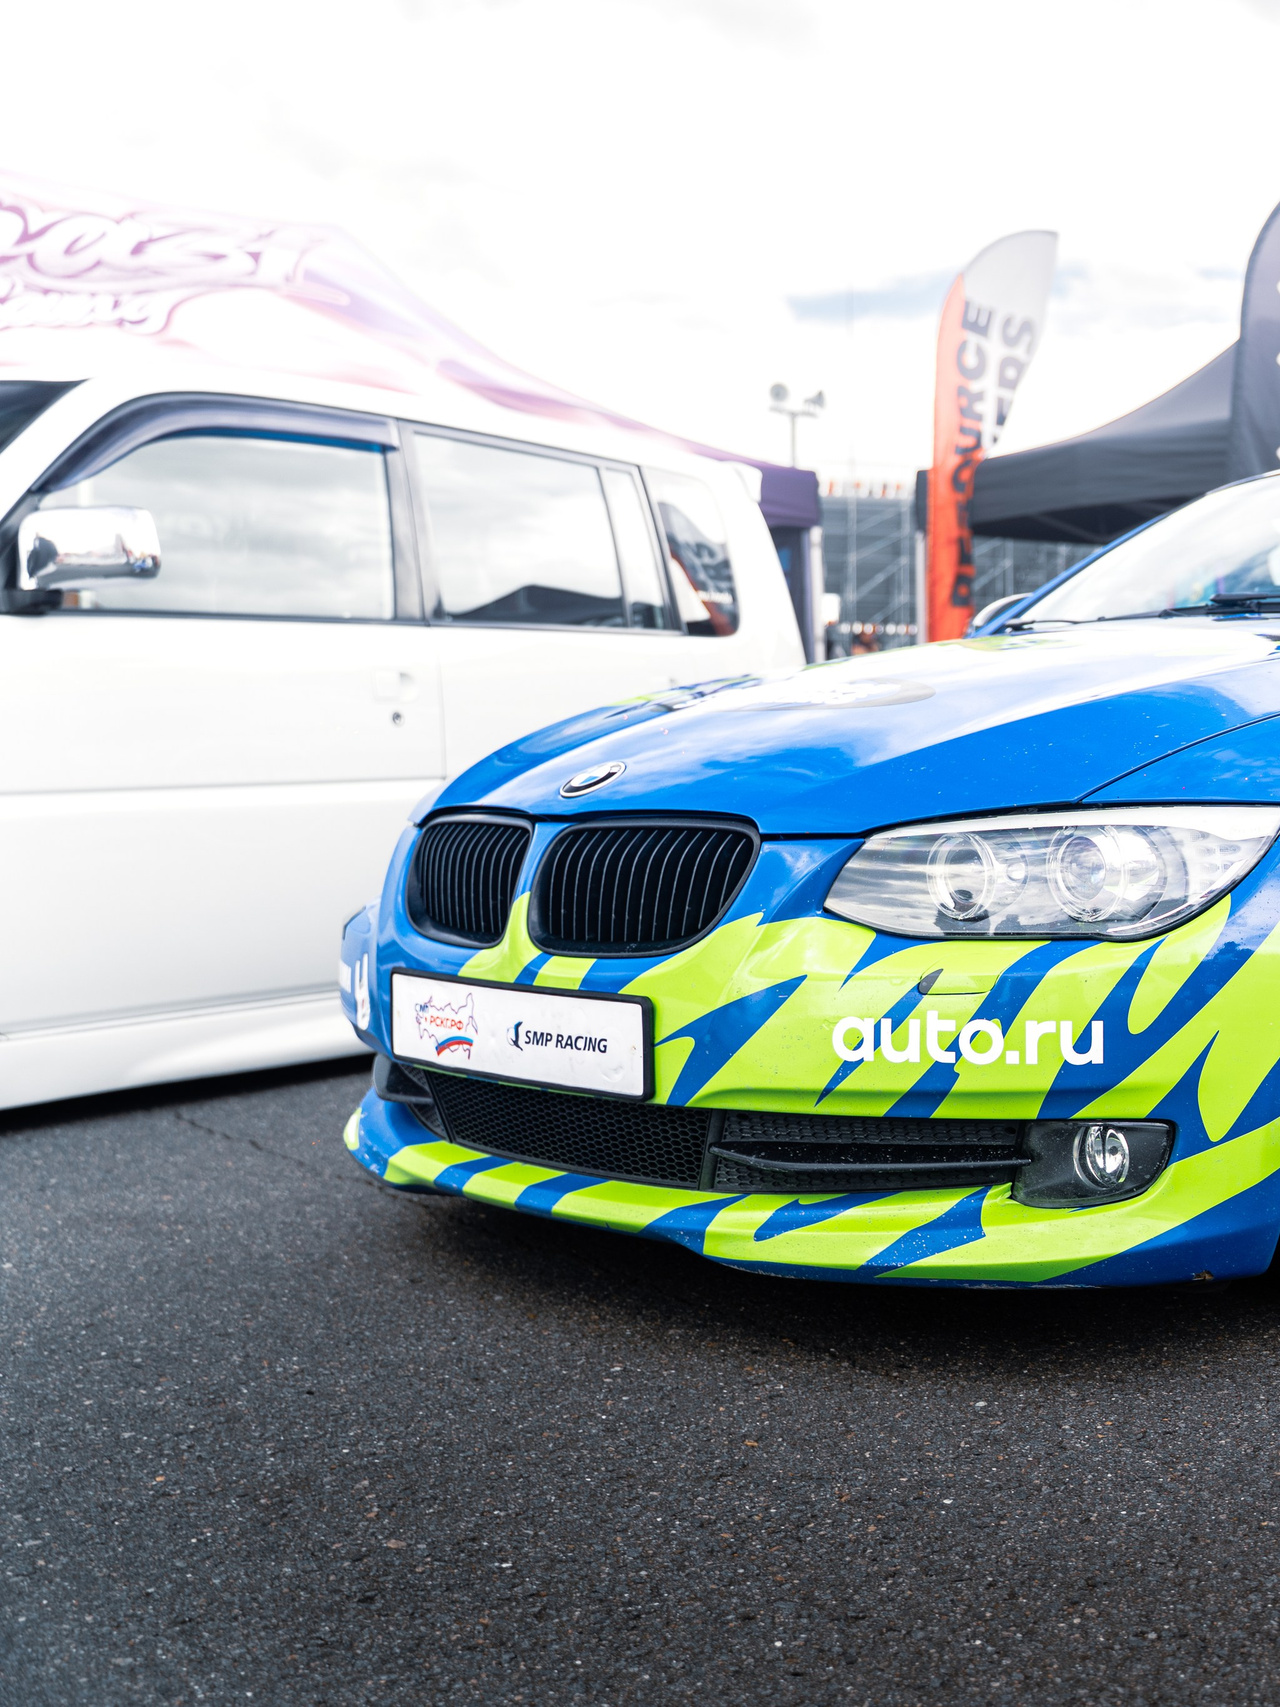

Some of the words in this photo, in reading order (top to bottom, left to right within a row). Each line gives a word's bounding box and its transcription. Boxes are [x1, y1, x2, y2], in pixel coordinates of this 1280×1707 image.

[524, 1029, 552, 1048] SMP
[555, 1034, 608, 1054] RACING
[832, 1009, 1104, 1067] auto.ru
